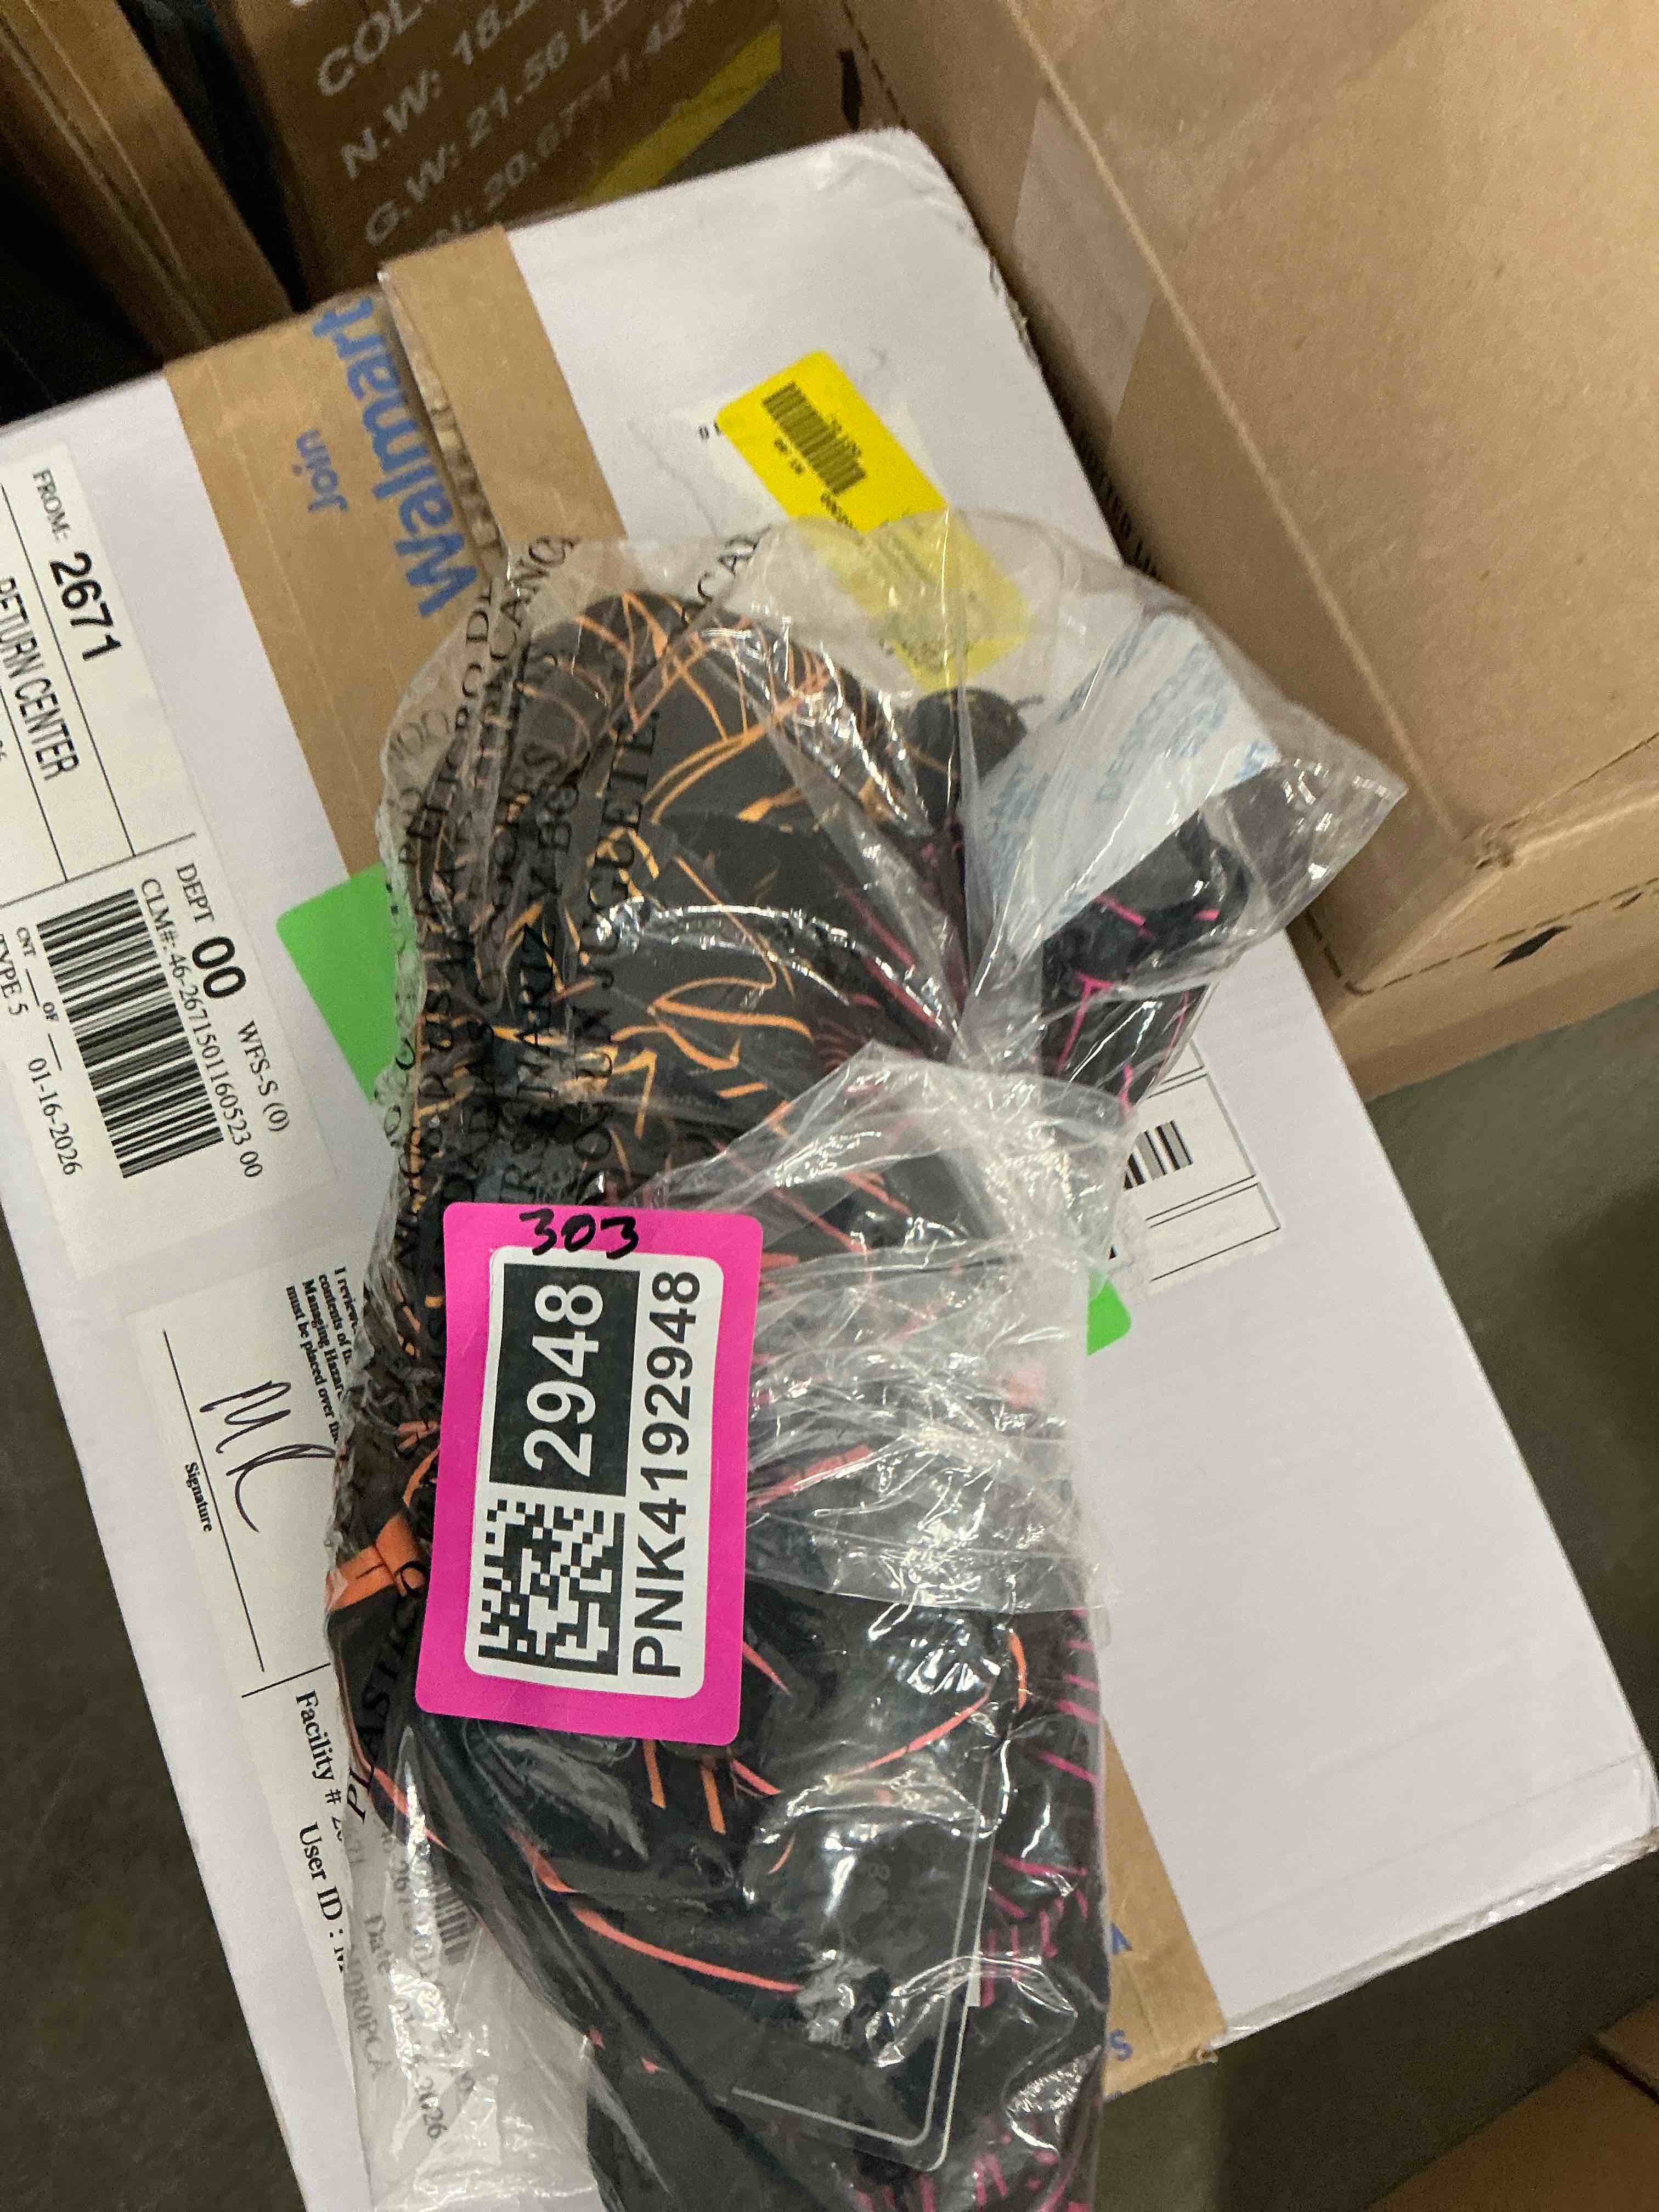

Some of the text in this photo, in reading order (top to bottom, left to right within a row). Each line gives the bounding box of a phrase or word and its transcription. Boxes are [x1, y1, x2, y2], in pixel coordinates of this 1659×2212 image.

[312, 297, 477, 618] Walmart
[32, 467, 122, 662] FROM: 2671
[15, 677, 80, 781] CENTER
[177, 863, 290, 1132] DEPT 00 WFS-S (0)
[8, 1003, 29, 1015] 5
[28, 1058, 83, 1175] 01-16-2026
[240, 1151, 263, 1177] 00
[520, 1208, 640, 1259] 303
[286, 1285, 306, 1321] must
[297, 1321, 310, 1339] be
[302, 1277, 330, 1348] Managing
[318, 1273, 343, 1331] contents
[337, 1333, 352, 1347] of
[300, 1340, 328, 1386] placed
[318, 1387, 335, 1419] over
[523, 1284, 604, 1479] 2948
[184, 1461, 213, 1533] Signature
[632, 1270, 701, 1678] PNK4192948
[295, 1689, 335, 1780] Facility
[325, 1788, 342, 1804] #
[299, 1820, 328, 1881] User
[317, 1885, 343, 1920] ID
